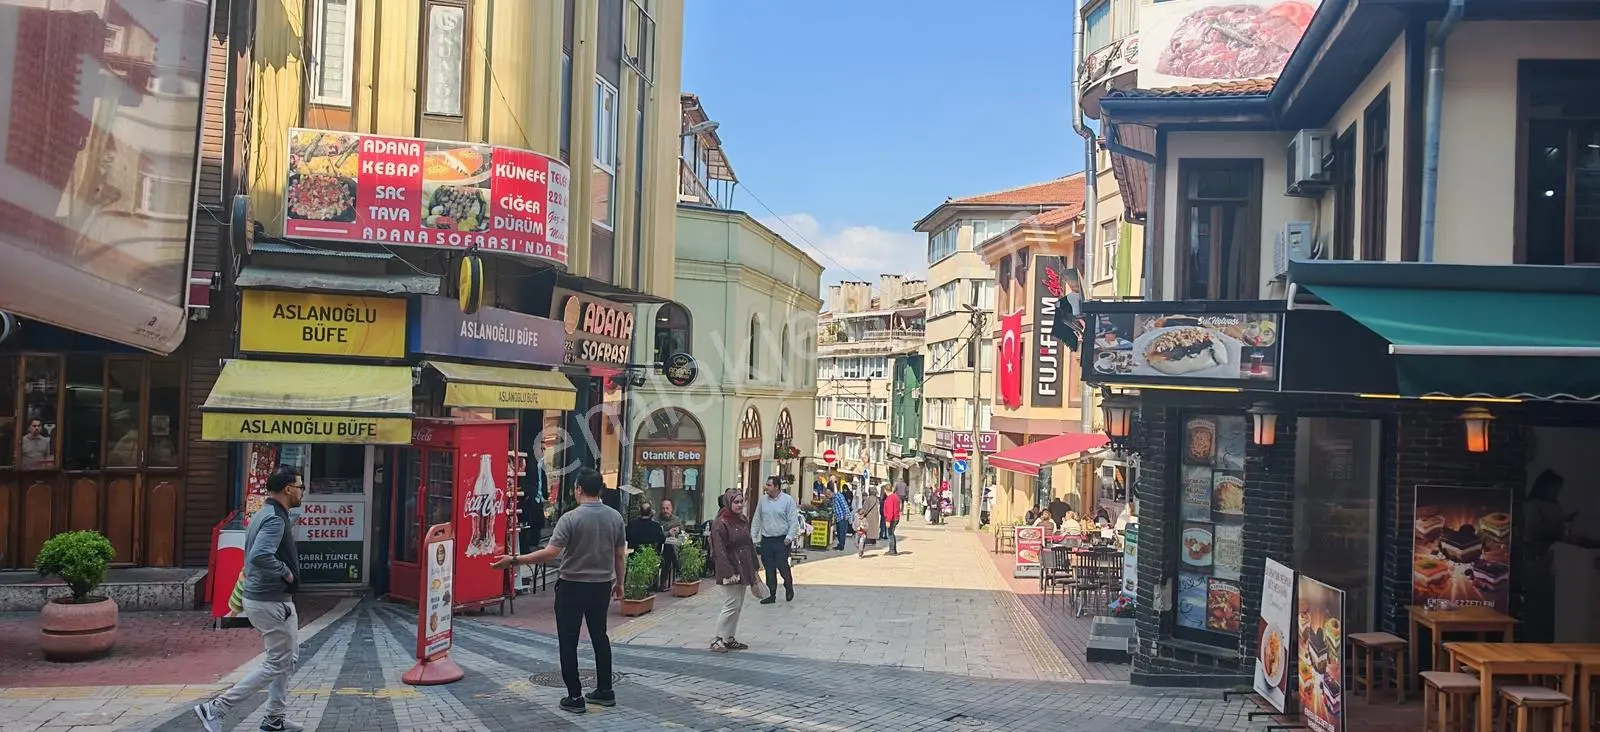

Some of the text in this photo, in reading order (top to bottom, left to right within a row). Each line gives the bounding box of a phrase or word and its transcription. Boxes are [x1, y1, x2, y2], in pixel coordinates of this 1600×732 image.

[363, 139, 420, 157] ADANA
[362, 160, 420, 177] KEBAP
[495, 161, 546, 184] KÜNEFE
[375, 185, 405, 200] SAC
[499, 193, 541, 214] CİĞER
[368, 206, 410, 221] TAVA
[493, 213, 544, 235] DÜRÜM
[362, 227, 428, 244] ADANA
[436, 230, 552, 256] SOFRASI'NDA
[272, 303, 377, 324] ASLANOĞLU
[583, 302, 634, 339] ADANA
[302, 323, 348, 343] BÜFE
[460, 320, 539, 347] ASLANOĞLU BÜFE
[581, 339, 629, 364] SOFRASI
[240, 417, 377, 437] ASLANOĞLU BÜFE
[956, 433, 991, 443] TRND
[642, 450, 701, 461] Otantik Bebe
[304, 504, 353, 514] KAAS
[297, 516, 355, 526] KESTANE
[307, 527, 349, 541] ŞEKERİ
[299, 562, 348, 570] LONYALARI
[325, 553, 359, 561] TUNCER
